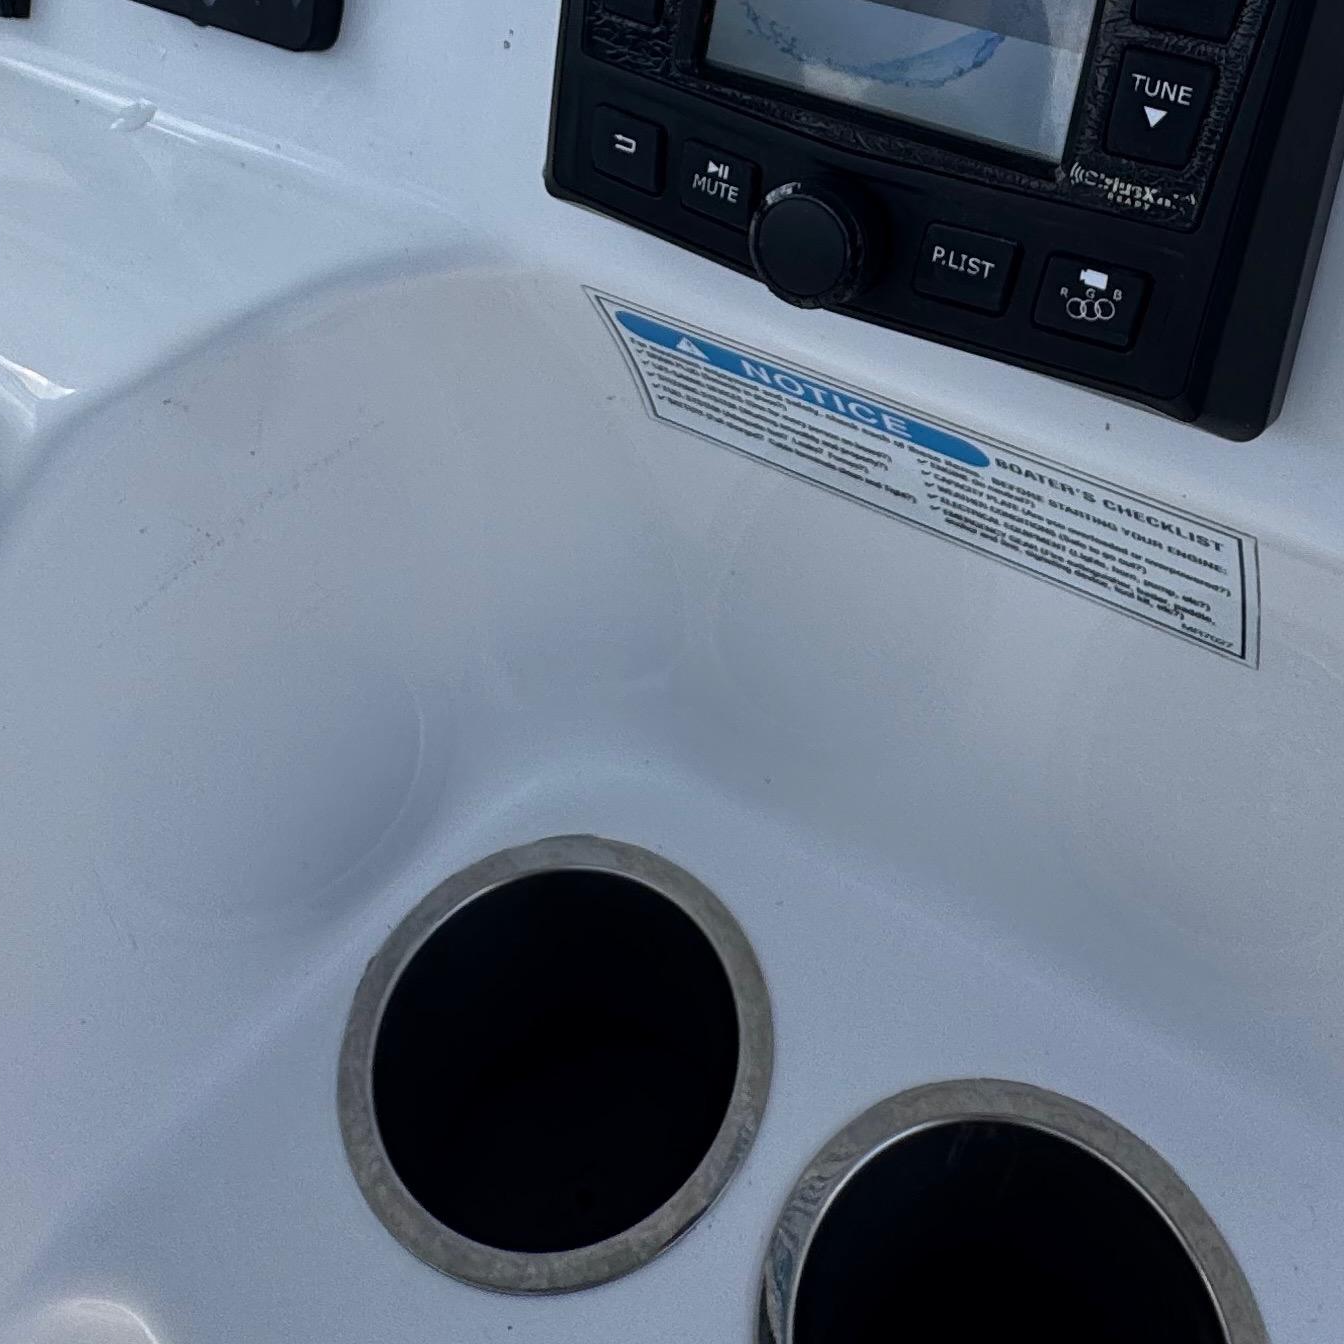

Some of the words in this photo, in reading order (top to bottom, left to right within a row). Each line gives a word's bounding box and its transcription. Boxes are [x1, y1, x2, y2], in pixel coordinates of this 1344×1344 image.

[1132, 73, 1193, 106] TUNE
[692, 173, 739, 204] MUTE
[932, 245, 995, 280] P.LIST
[740, 359, 912, 438] NOTICE
[993, 457, 1096, 503] BOATER'S
[1102, 498, 1223, 551] CHECKLIST
[1121, 527, 1163, 547] YOUR
